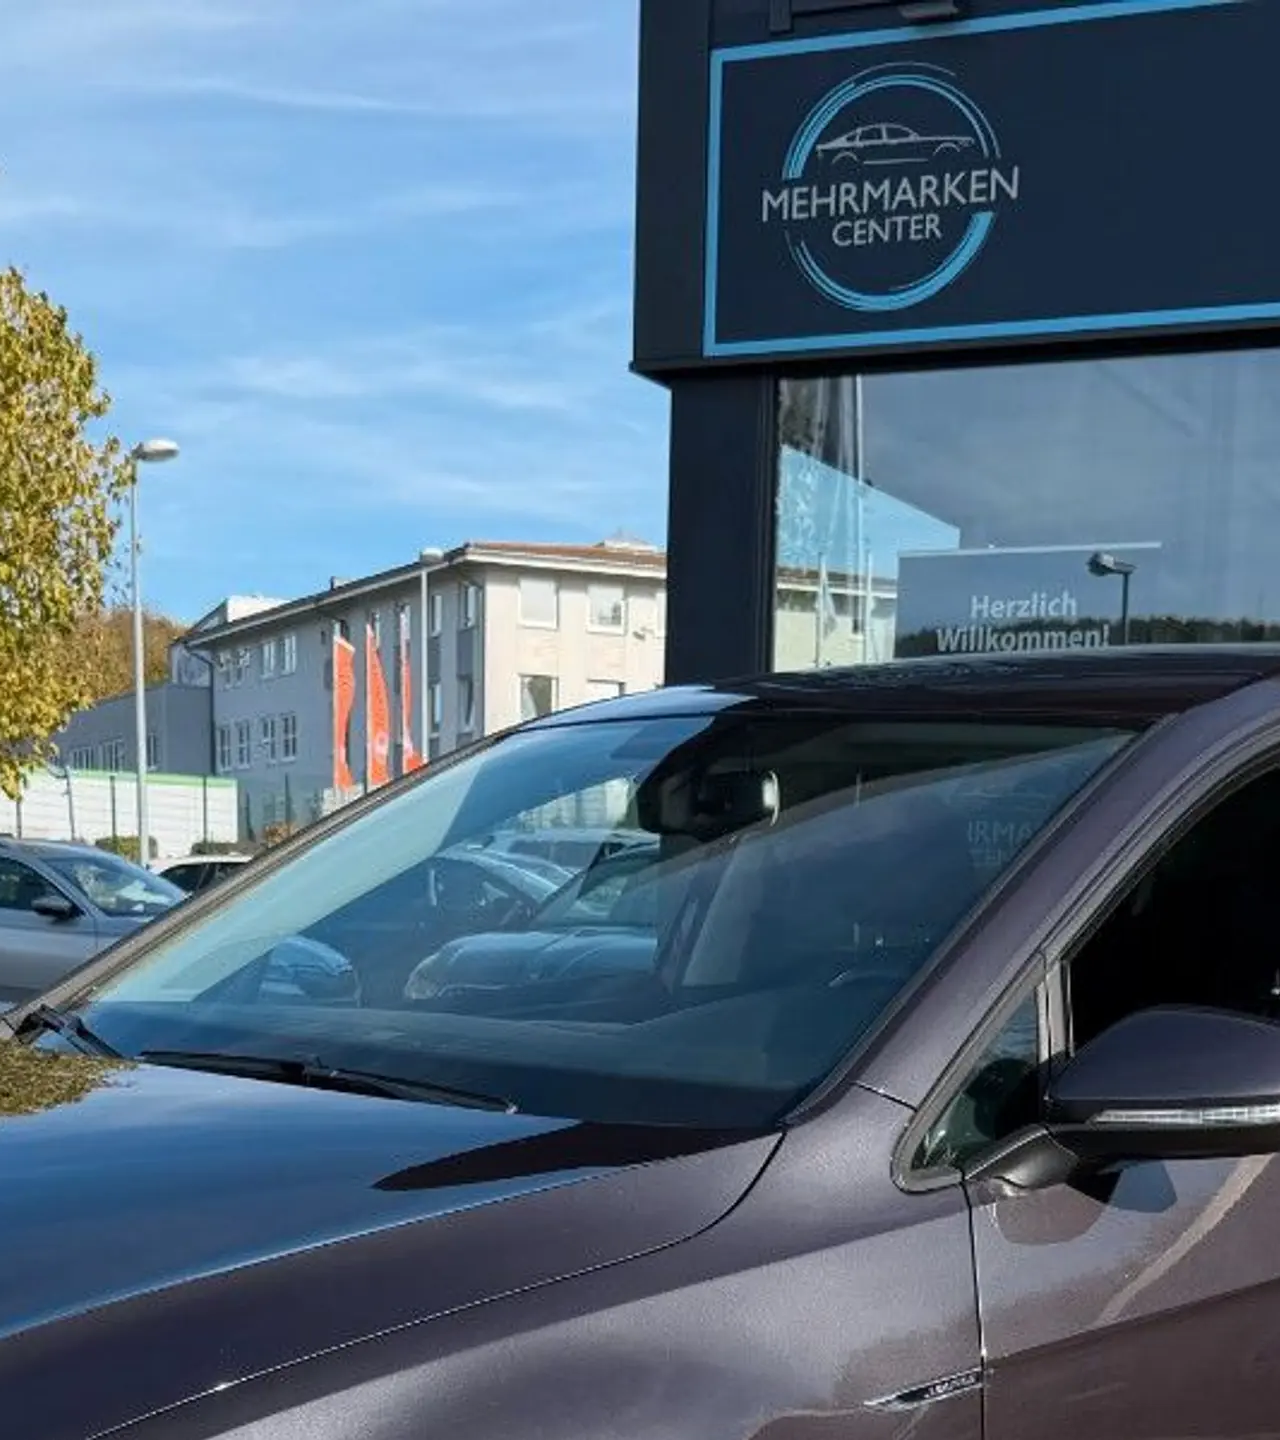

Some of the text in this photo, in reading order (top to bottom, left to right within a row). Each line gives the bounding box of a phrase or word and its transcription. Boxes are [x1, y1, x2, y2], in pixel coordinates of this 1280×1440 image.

[761, 165, 1020, 222] MEHRMARKEN
[832, 213, 943, 247] CENTER
[970, 591, 1078, 619] Herzlich
[936, 623, 1111, 652] Willkommen!
